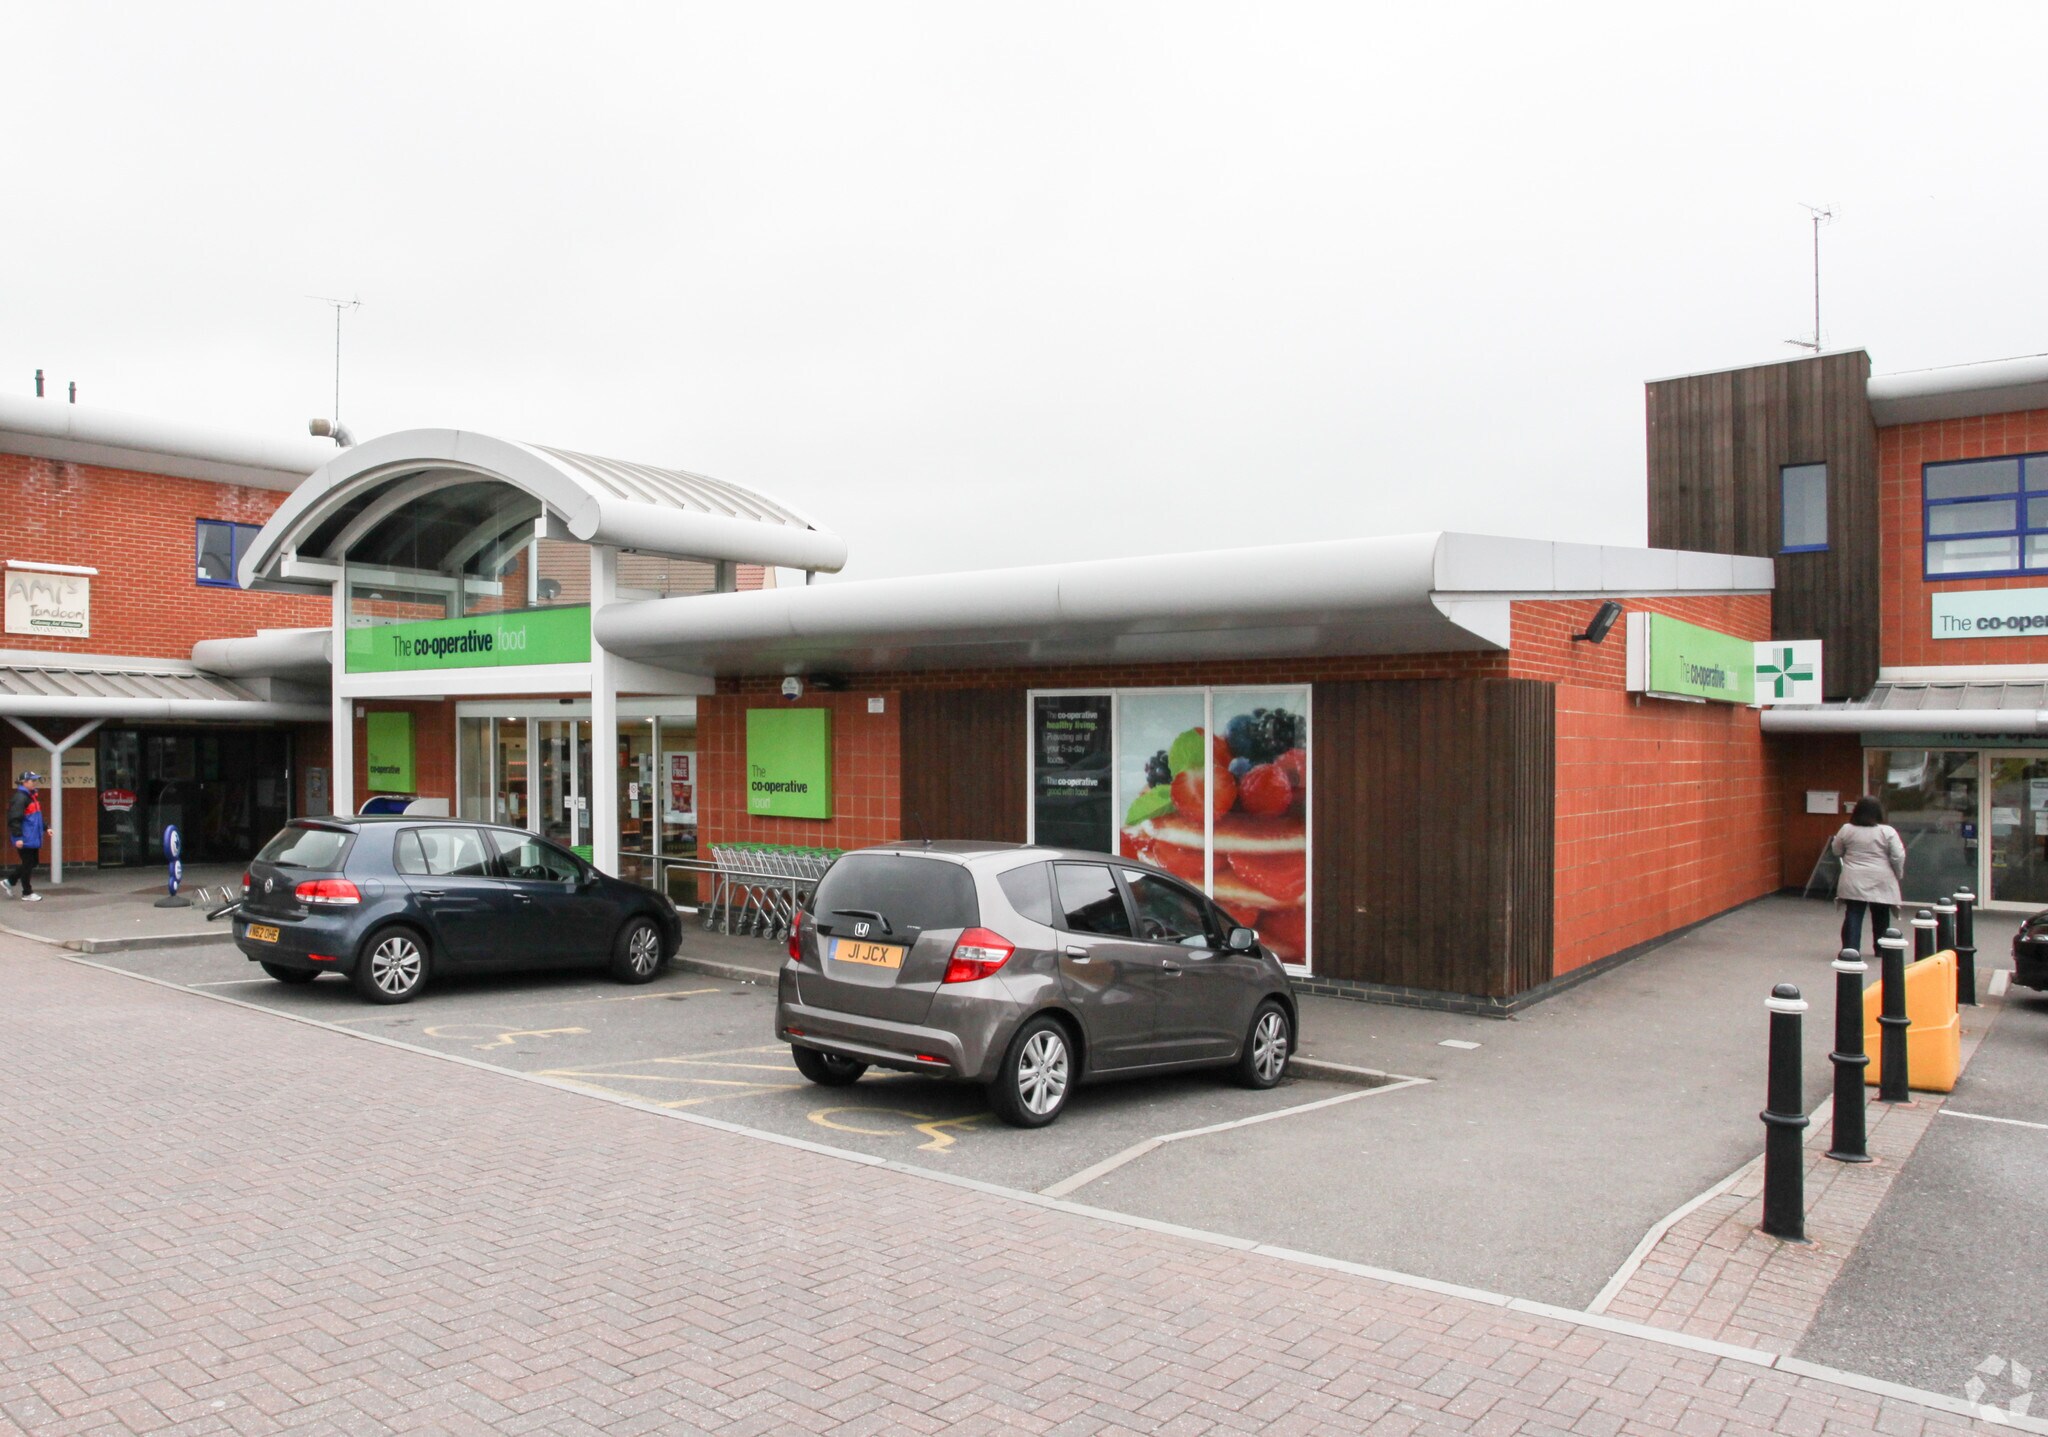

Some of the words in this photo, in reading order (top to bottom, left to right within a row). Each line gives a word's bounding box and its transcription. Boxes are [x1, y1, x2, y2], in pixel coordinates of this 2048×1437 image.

[30, 604, 86, 620] Tandoori
[1940, 615, 1972, 631] The
[393, 635, 412, 657] The
[414, 629, 493, 659] co-operative
[497, 625, 526, 651] food
[1679, 655, 1690, 683] The
[1690, 663, 1725, 691] co-operative
[1047, 711, 1057, 719] The
[1058, 711, 1098, 720] co-operative
[1046, 721, 1073, 731] healthy
[1046, 732, 1074, 743] Providing
[1046, 746, 1060, 755] your
[1061, 745, 1085, 755] 5-a-day
[672, 769, 687, 777] FREE
[752, 765, 766, 778] The
[752, 780, 808, 795] co-operative
[1046, 776, 1057, 785] The
[1058, 777, 1098, 787] co-operative
[862, 946, 889, 963] JCX
